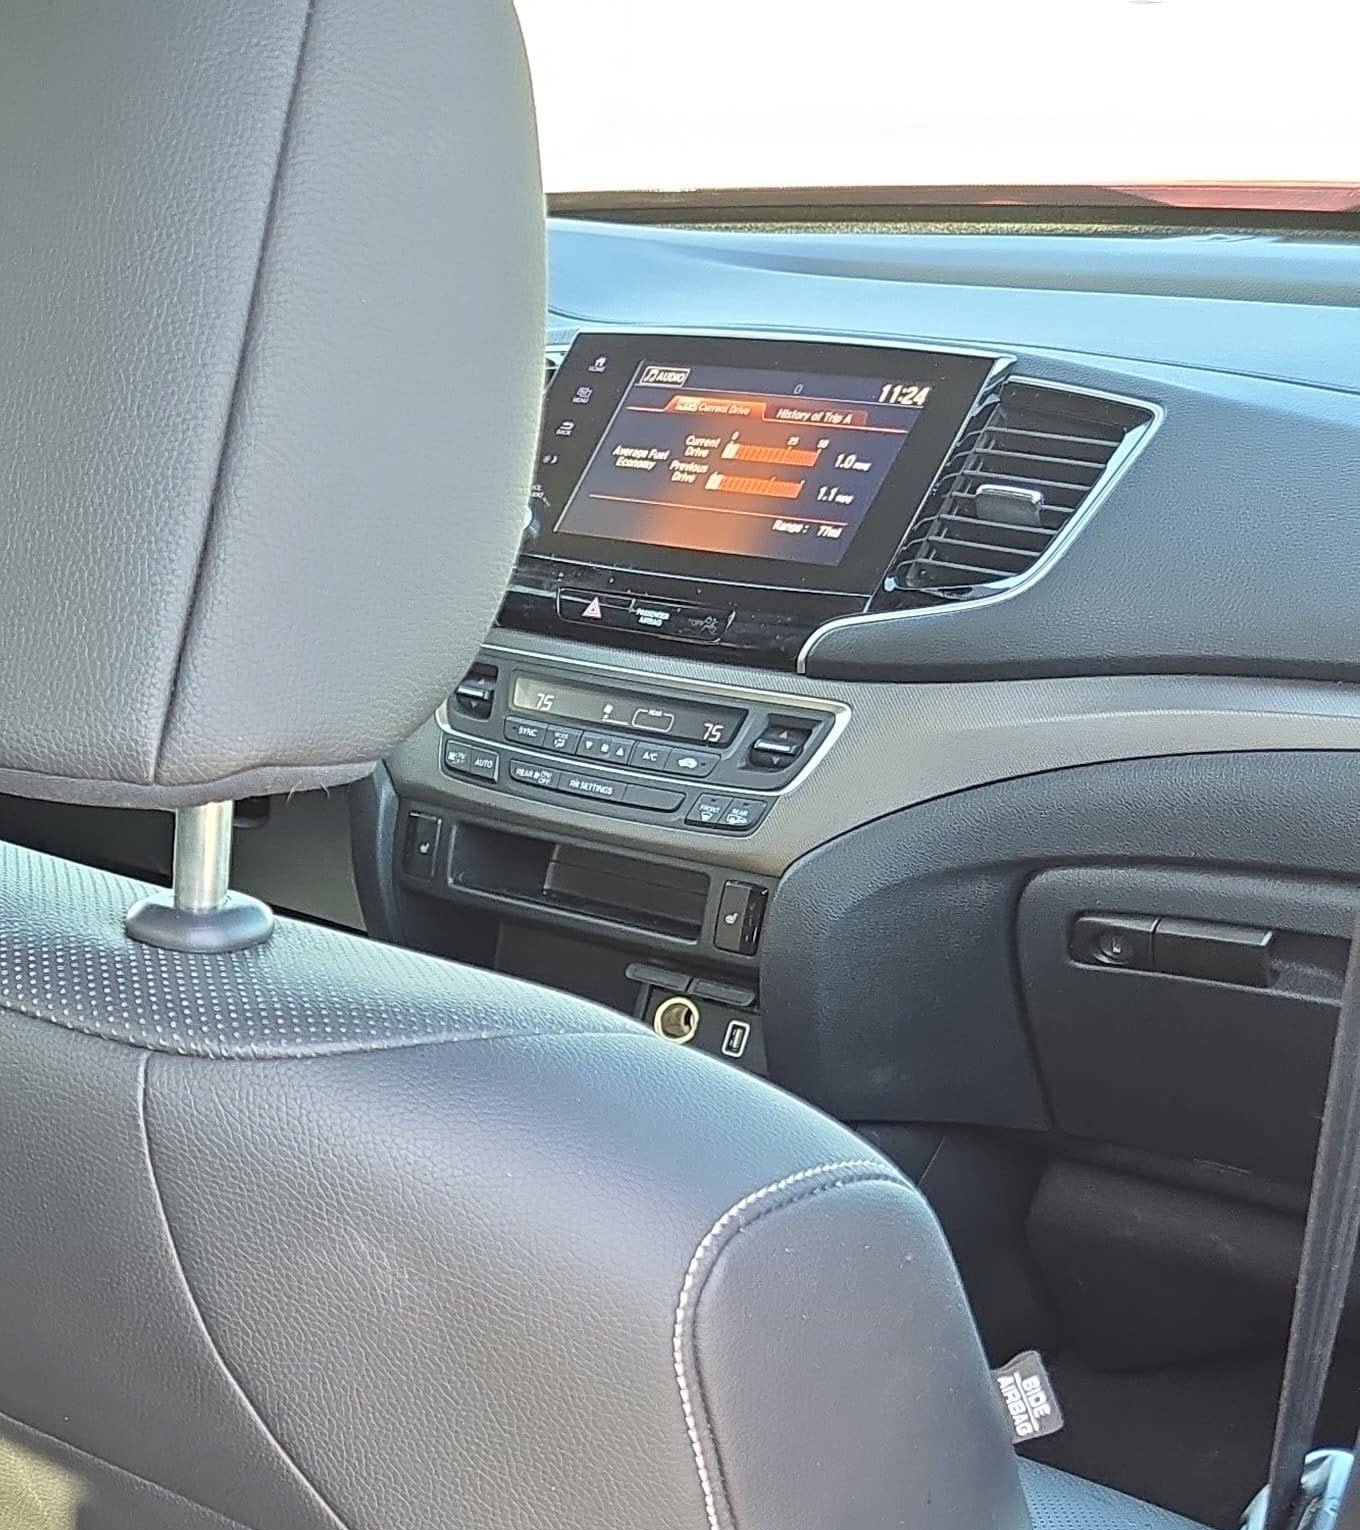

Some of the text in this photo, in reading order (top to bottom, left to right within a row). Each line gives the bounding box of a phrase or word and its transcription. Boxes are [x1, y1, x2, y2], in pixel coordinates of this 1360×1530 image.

[656, 372, 686, 383] AUDIO
[878, 384, 930, 406] 11:24
[698, 402, 751, 416] Current Drive
[776, 409, 852, 425] History of Trip A
[685, 436, 720, 449] Current
[612, 445, 670, 460] Average Fuel
[684, 446, 710, 458] Drive
[616, 457, 657, 471] Economy
[669, 460, 709, 475] Previous
[834, 453, 856, 469] 1.0
[671, 470, 696, 484] Drive
[816, 486, 837, 502] 1.1
[536, 693, 555, 711] 75
[518, 726, 538, 737] SYNC
[703, 722, 724, 742] 75
[642, 750, 658, 761] A/C
[474, 758, 493, 768] AUTO
[516, 768, 533, 778] REAR
[581, 781, 613, 795] SETTINGS
[699, 804, 720, 813] FRONT
[732, 808, 748, 817] REAR
[997, 1375, 1033, 1437] AIRBAG
